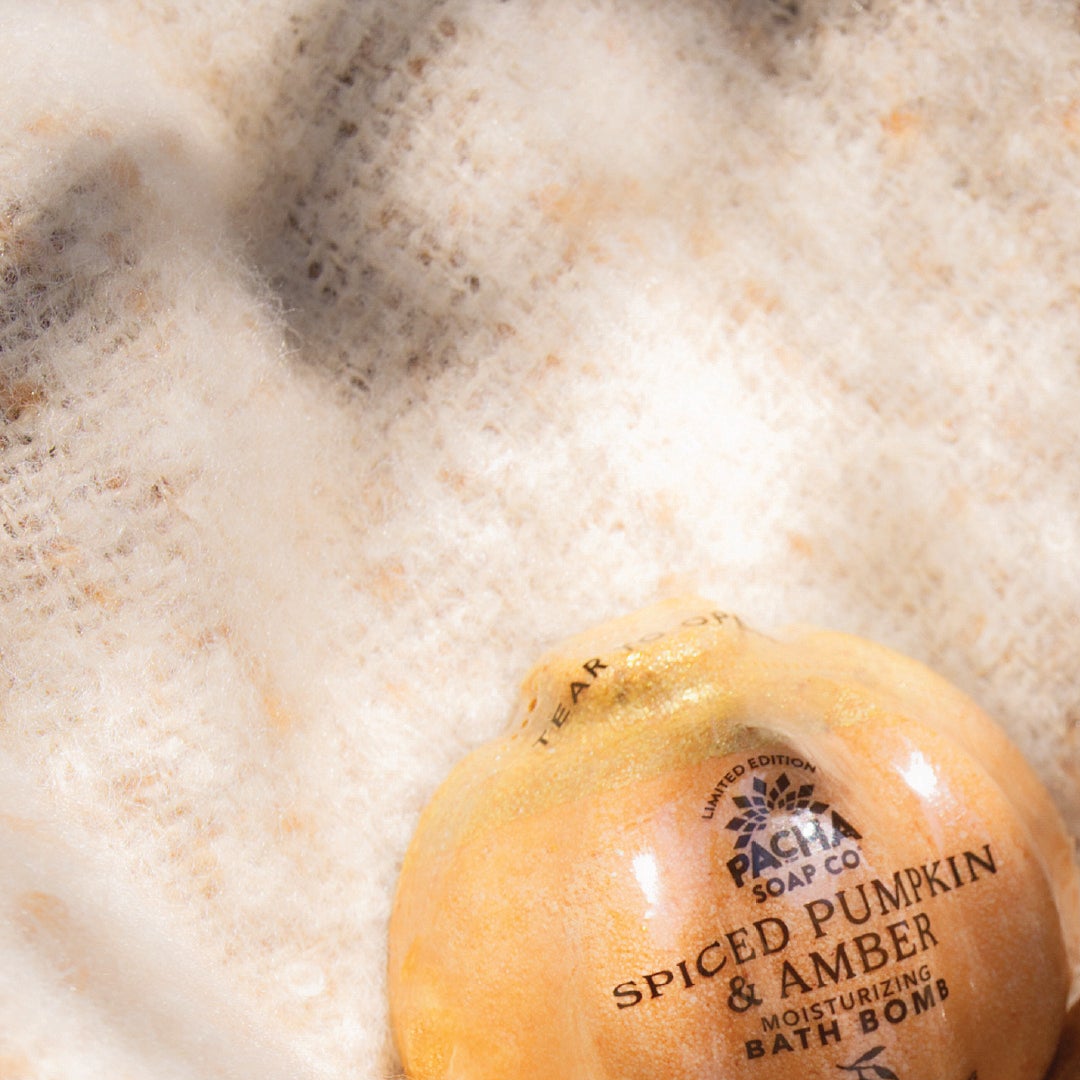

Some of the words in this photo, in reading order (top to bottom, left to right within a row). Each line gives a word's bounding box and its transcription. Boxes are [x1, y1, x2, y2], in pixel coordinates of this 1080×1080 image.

[532, 658, 608, 747] TEAR
[702, 764, 746, 820] LIMITED
[747, 754, 817, 774] EDITION
[726, 810, 863, 889] PACHA
[752, 863, 816, 904] SOAP
[824, 849, 860, 875] CO
[612, 916, 790, 1011] SPICED
[803, 843, 999, 939] PUMPKIN
[727, 975, 763, 1014] &
[780, 911, 939, 999] AMBER
[744, 1019, 841, 1060] BATH
[858, 977, 950, 1035] BOMB
[760, 964, 932, 1033] MOISTURIZING
